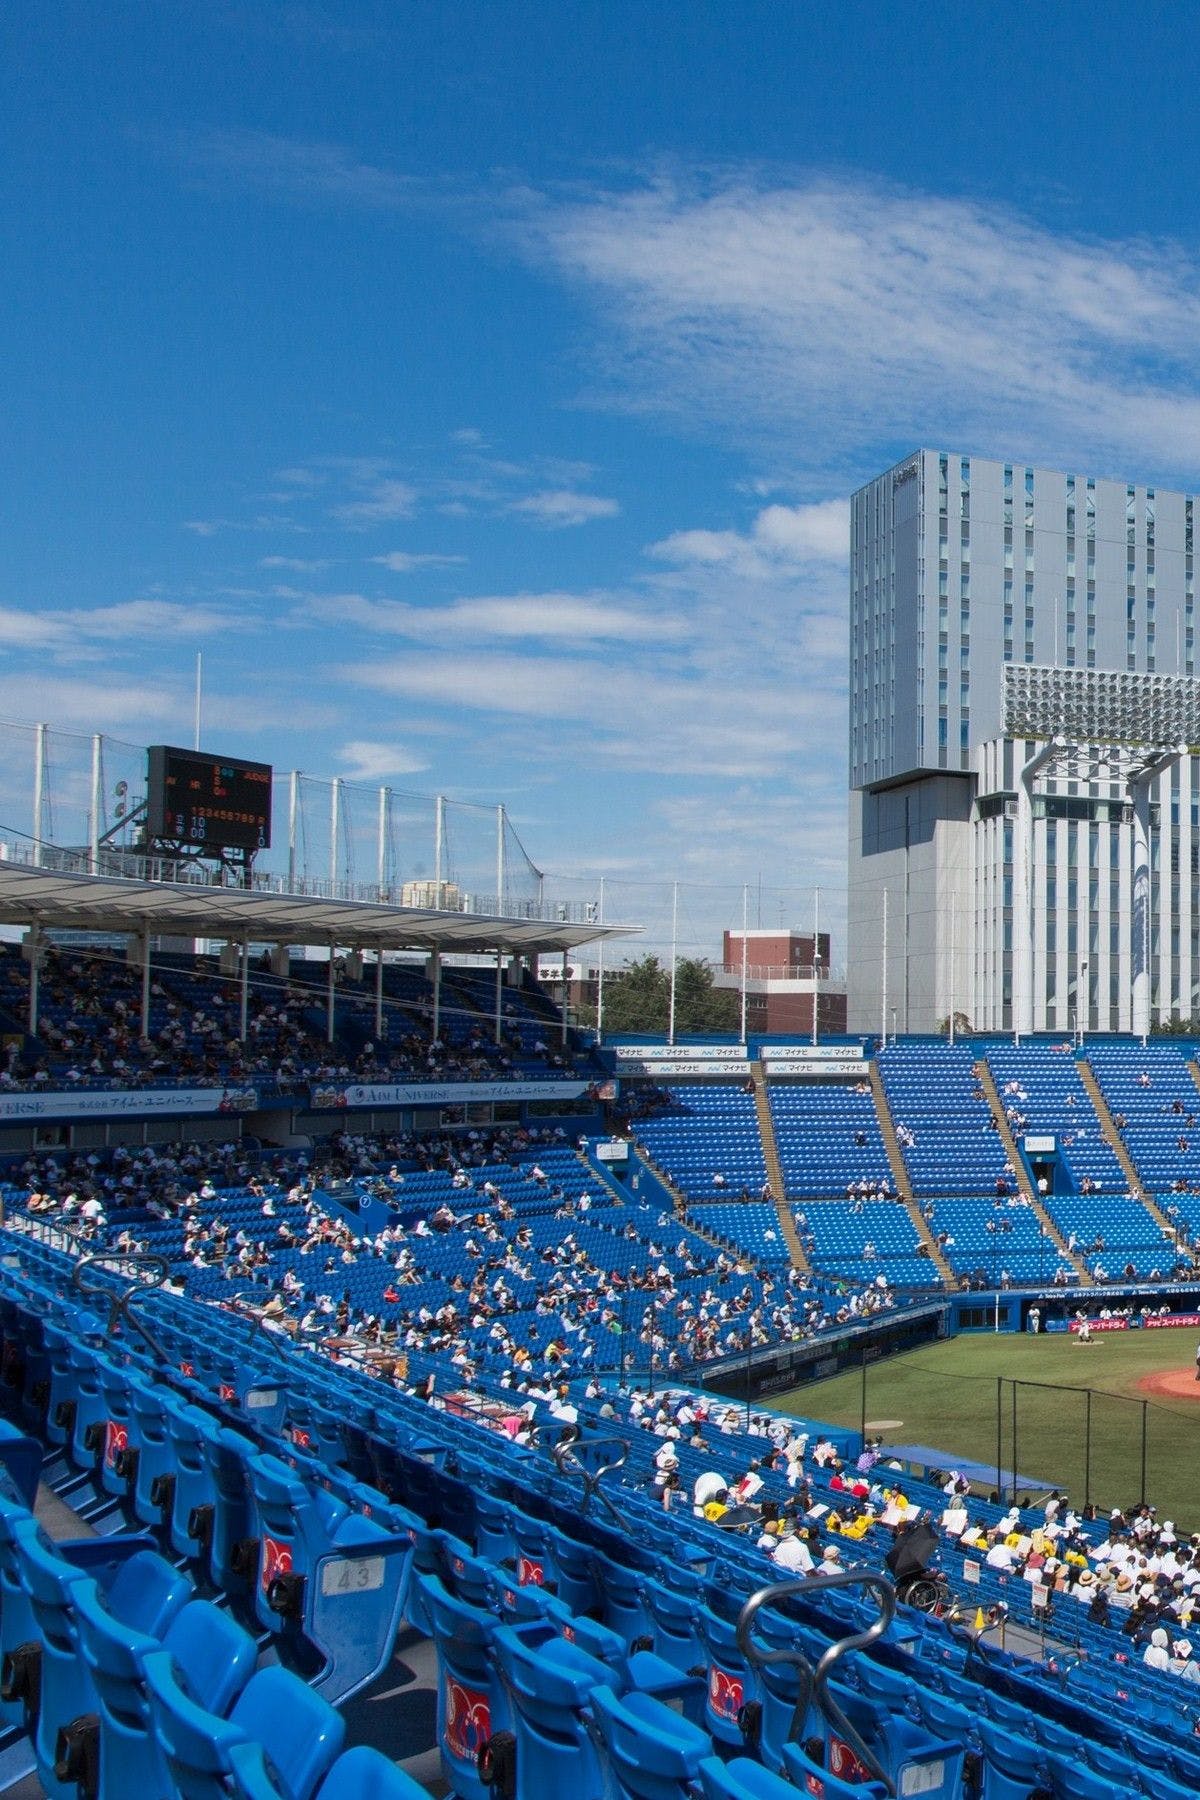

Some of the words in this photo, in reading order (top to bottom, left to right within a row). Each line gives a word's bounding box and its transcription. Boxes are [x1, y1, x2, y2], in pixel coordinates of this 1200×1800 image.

[784, 1048, 808, 1056] マイナビ
[834, 1048, 857, 1056] マイナビ
[789, 1064, 812, 1072] マイナビ
[839, 1064, 863, 1072] マイナビ
[337, 1567, 370, 1590] 43
